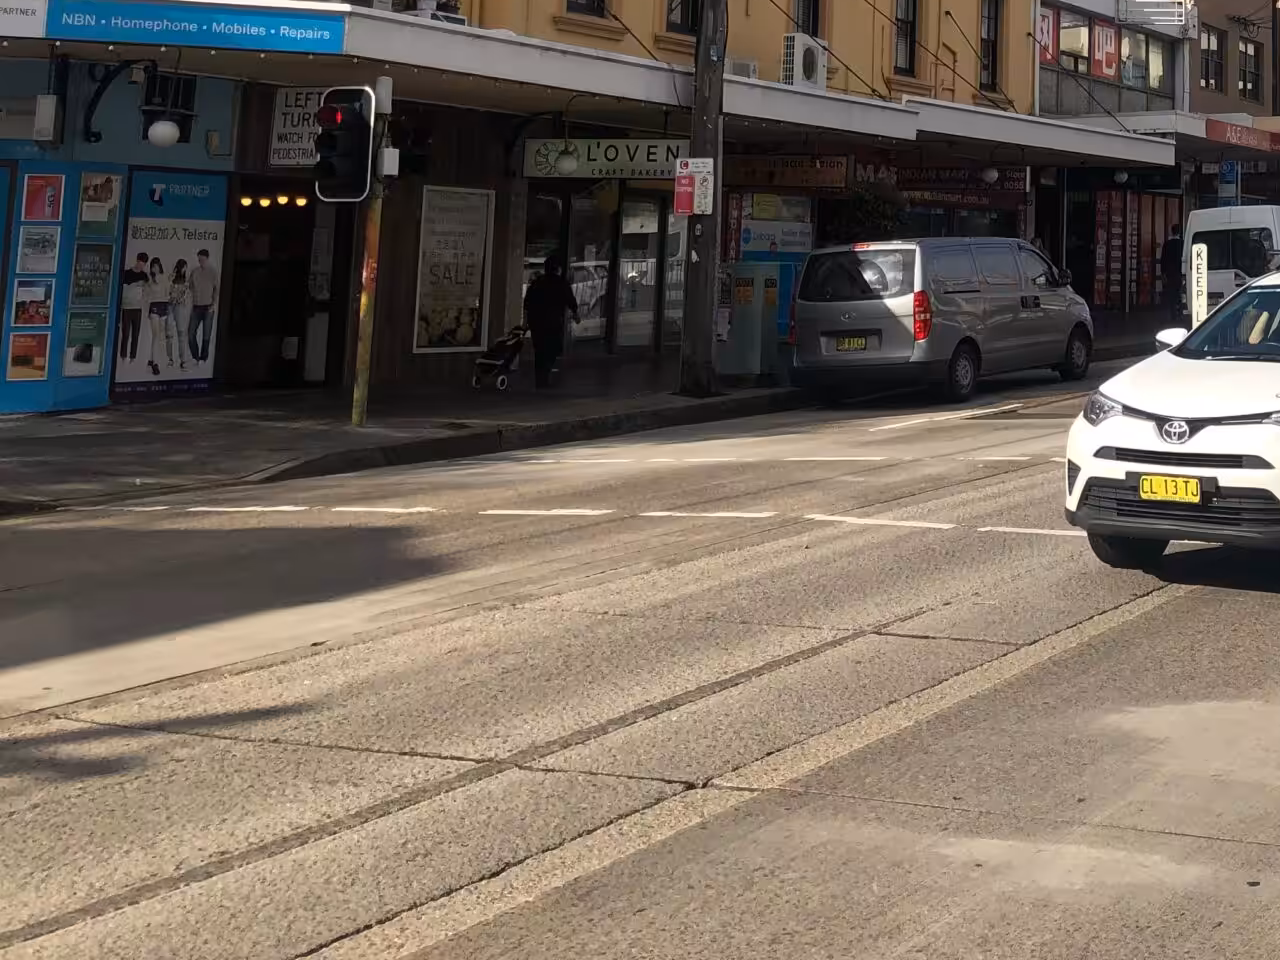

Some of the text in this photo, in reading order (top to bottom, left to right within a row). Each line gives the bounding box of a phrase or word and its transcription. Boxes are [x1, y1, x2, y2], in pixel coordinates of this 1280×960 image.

[62, 12, 331, 41] NBN Homephone Mobiles Repairs
[276, 132, 304, 144] WATCH
[272, 148, 316, 160] PEDESTRIA
[587, 141, 680, 162] L'OVEN
[182, 228, 218, 241] Telstra
